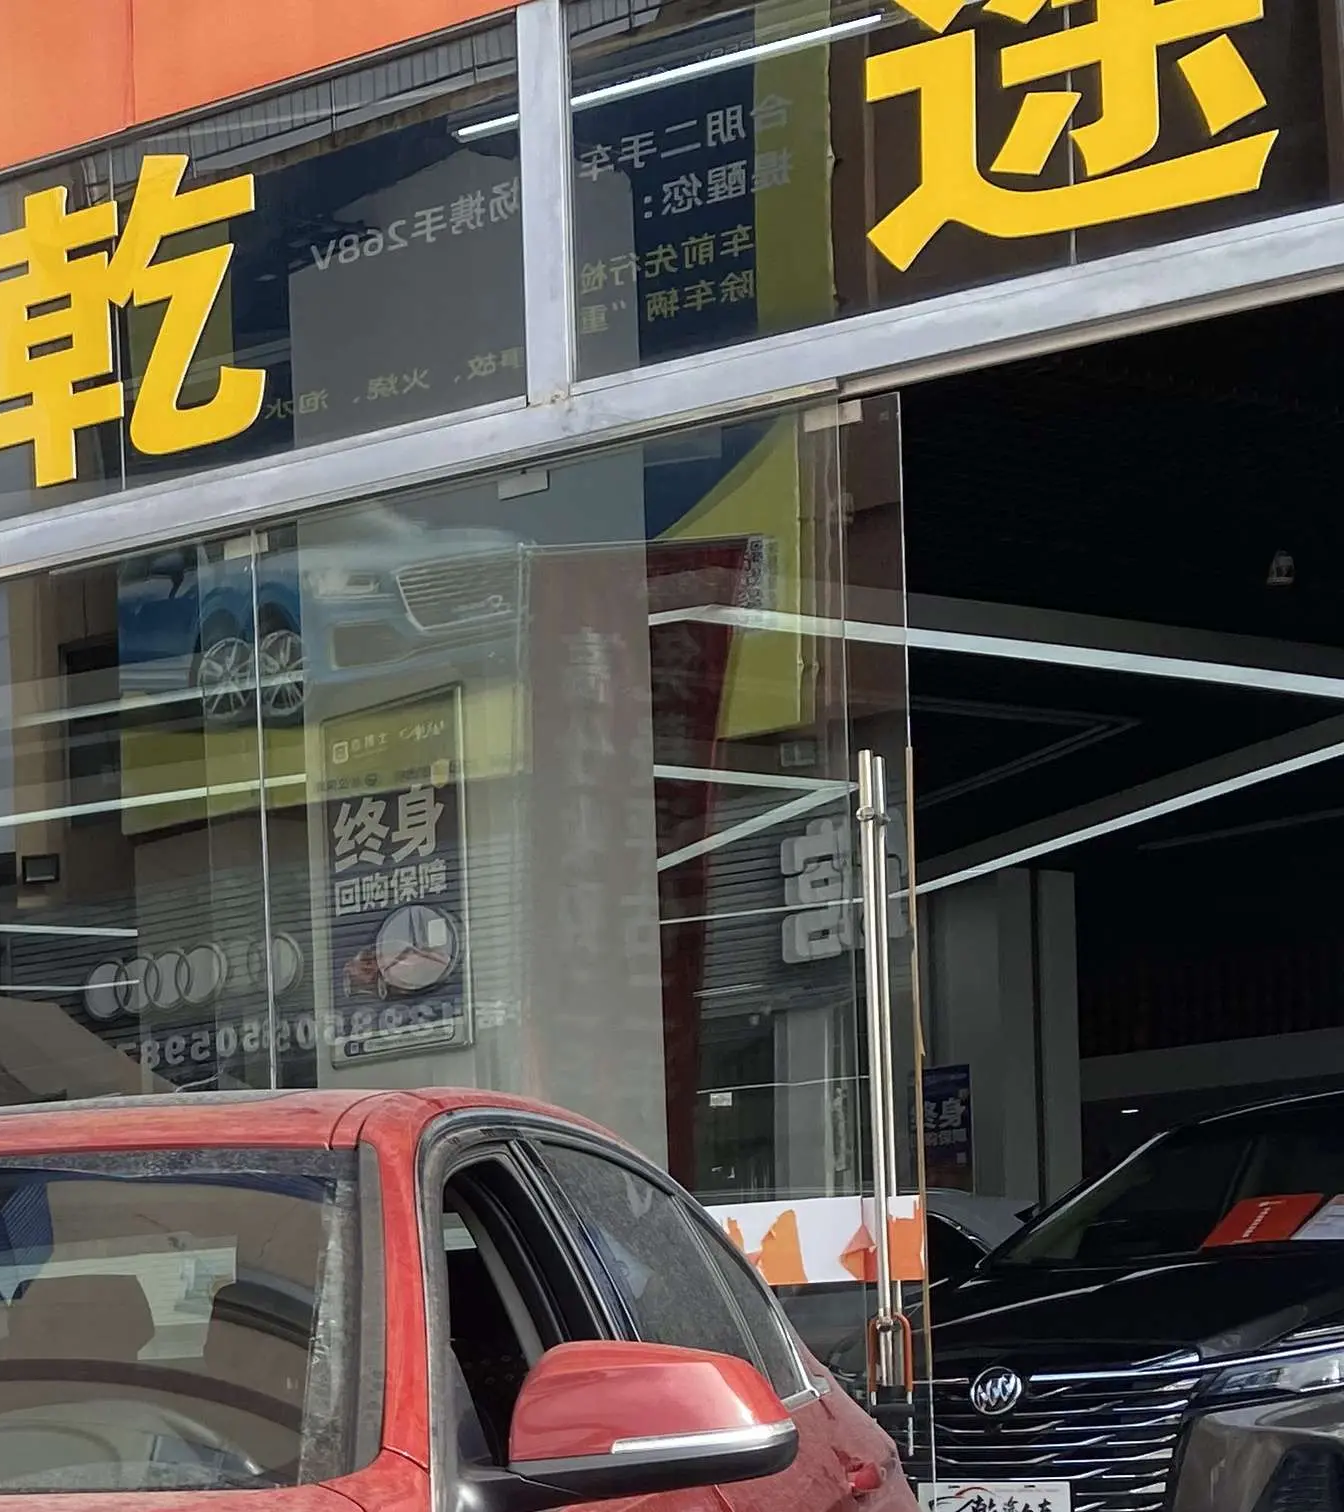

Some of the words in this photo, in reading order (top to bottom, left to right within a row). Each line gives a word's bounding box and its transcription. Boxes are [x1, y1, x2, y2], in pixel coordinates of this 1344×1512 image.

[866, 0, 1278, 272] 途
[333, 784, 445, 873] 终身
[334, 858, 449, 917] 回购保障
